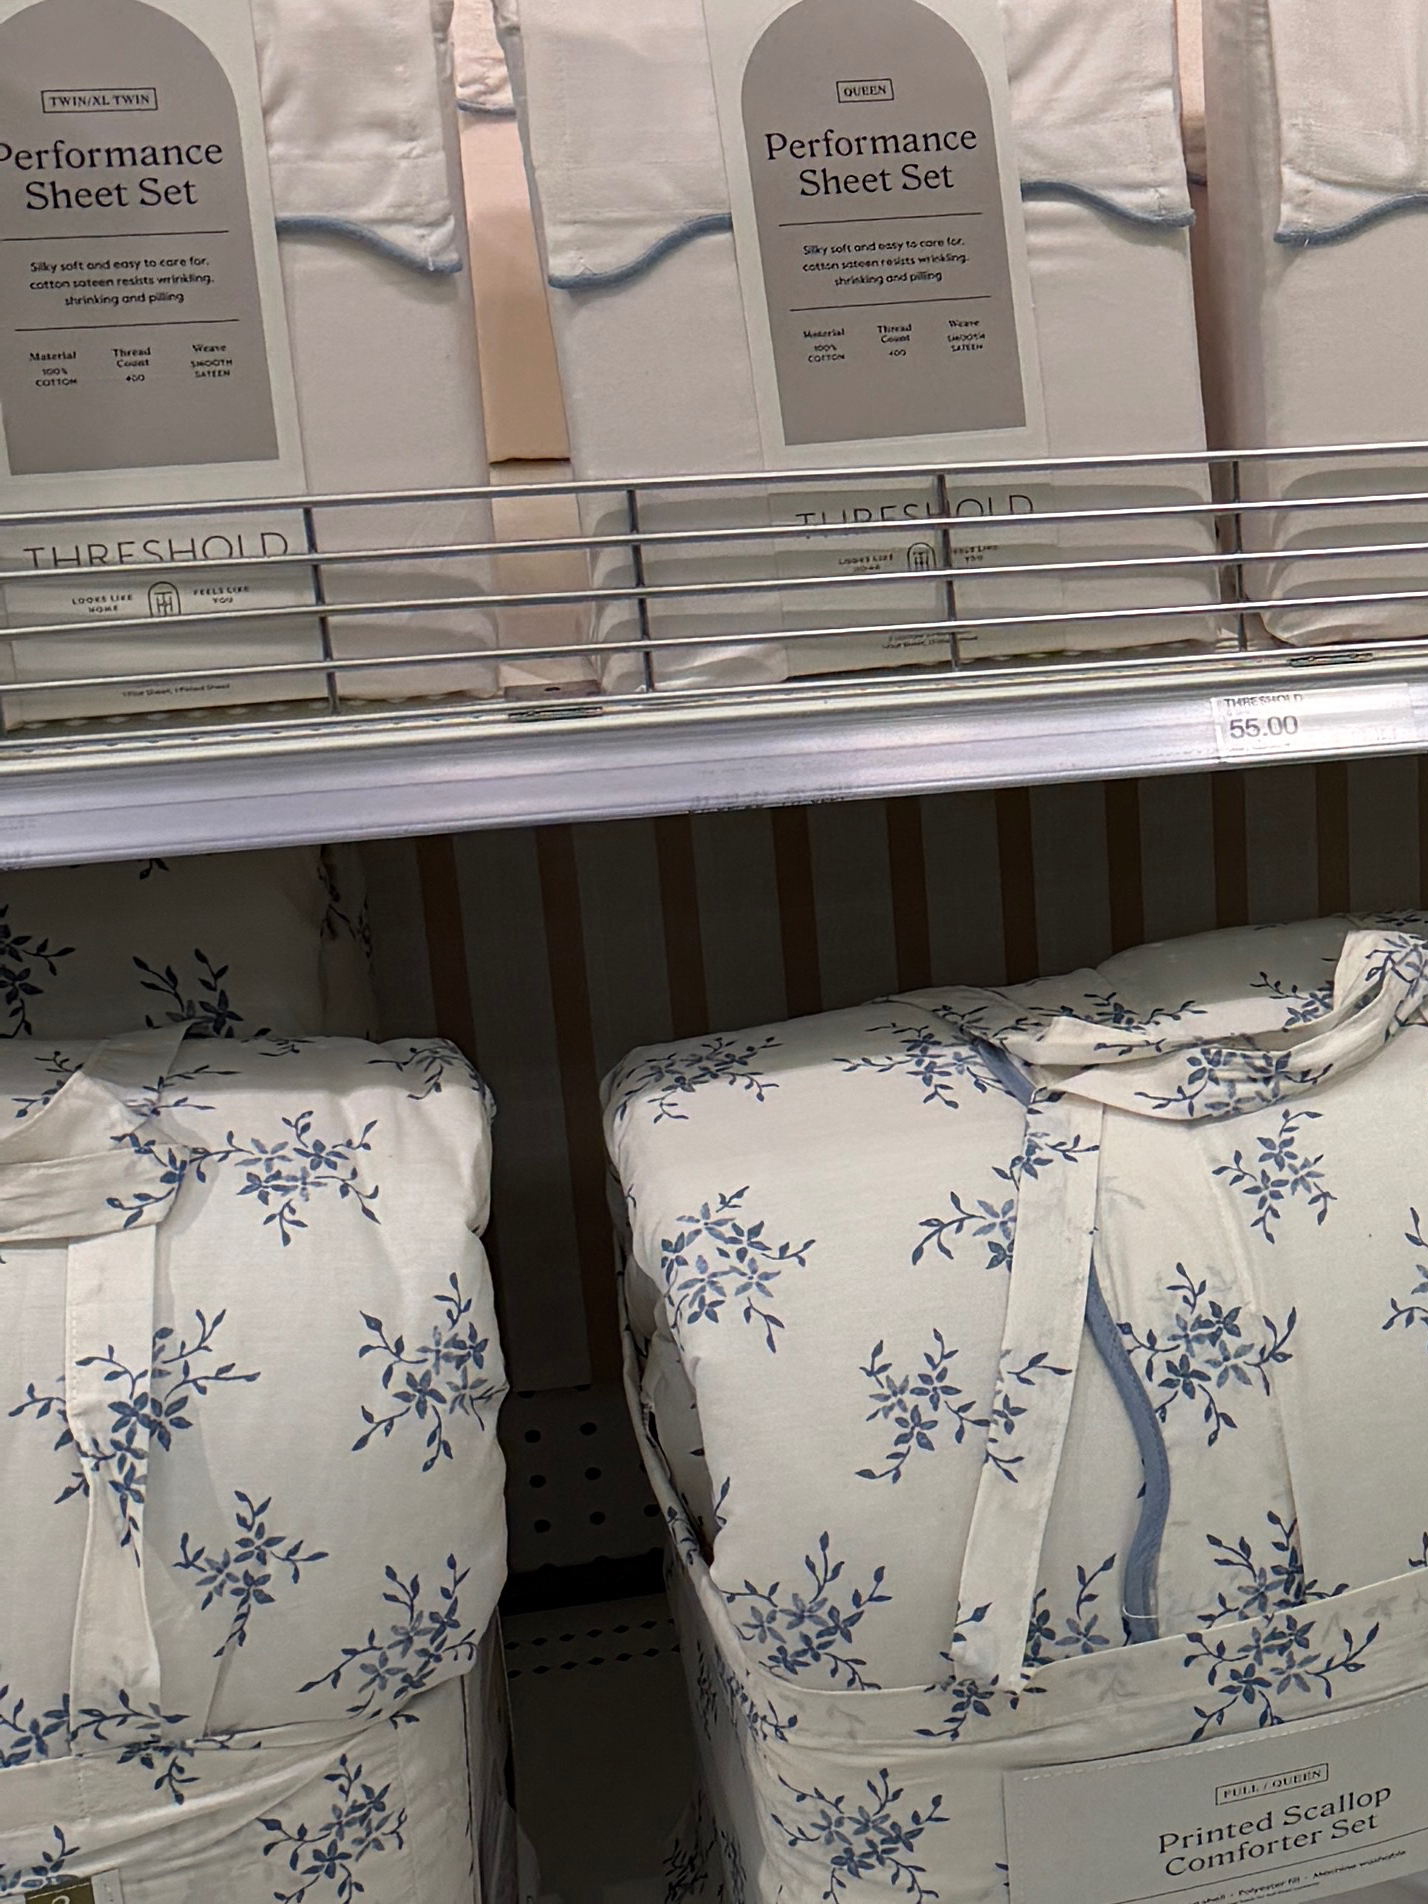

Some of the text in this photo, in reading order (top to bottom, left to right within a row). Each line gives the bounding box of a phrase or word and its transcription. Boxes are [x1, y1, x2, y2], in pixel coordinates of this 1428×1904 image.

[843, 84, 887, 97] QUEEN
[49, 95, 150, 107] TWIN/XL TWIN
[765, 129, 977, 160] Performance
[800, 163, 954, 196] Sheet Set
[26, 178, 199, 210] Sheet Set
[803, 245, 827, 256] Silky
[830, 244, 852, 254] soft
[854, 243, 876, 252] and
[878, 242, 904, 252] easy
[919, 240, 944, 248] care
[30, 259, 186, 273] Silky soft and easy to care
[802, 262, 839, 272] cotton
[842, 260, 879, 269] sateen
[29, 276, 154, 290] cotton sateen resists
[886, 273, 908, 283] and
[65, 294, 119, 307] shrinking
[122, 293, 145, 304] and
[29, 351, 77, 362] Material
[112, 347, 151, 357] Thread
[1224, 694, 1304, 708] THRESHOLD
[1229, 715, 1298, 739] 55.00
[1223, 1768, 1323, 1800] FULL QUEEN
[1159, 1786, 1392, 1854] Printed Scallop
[1165, 1814, 1379, 1877] Comforter Set
